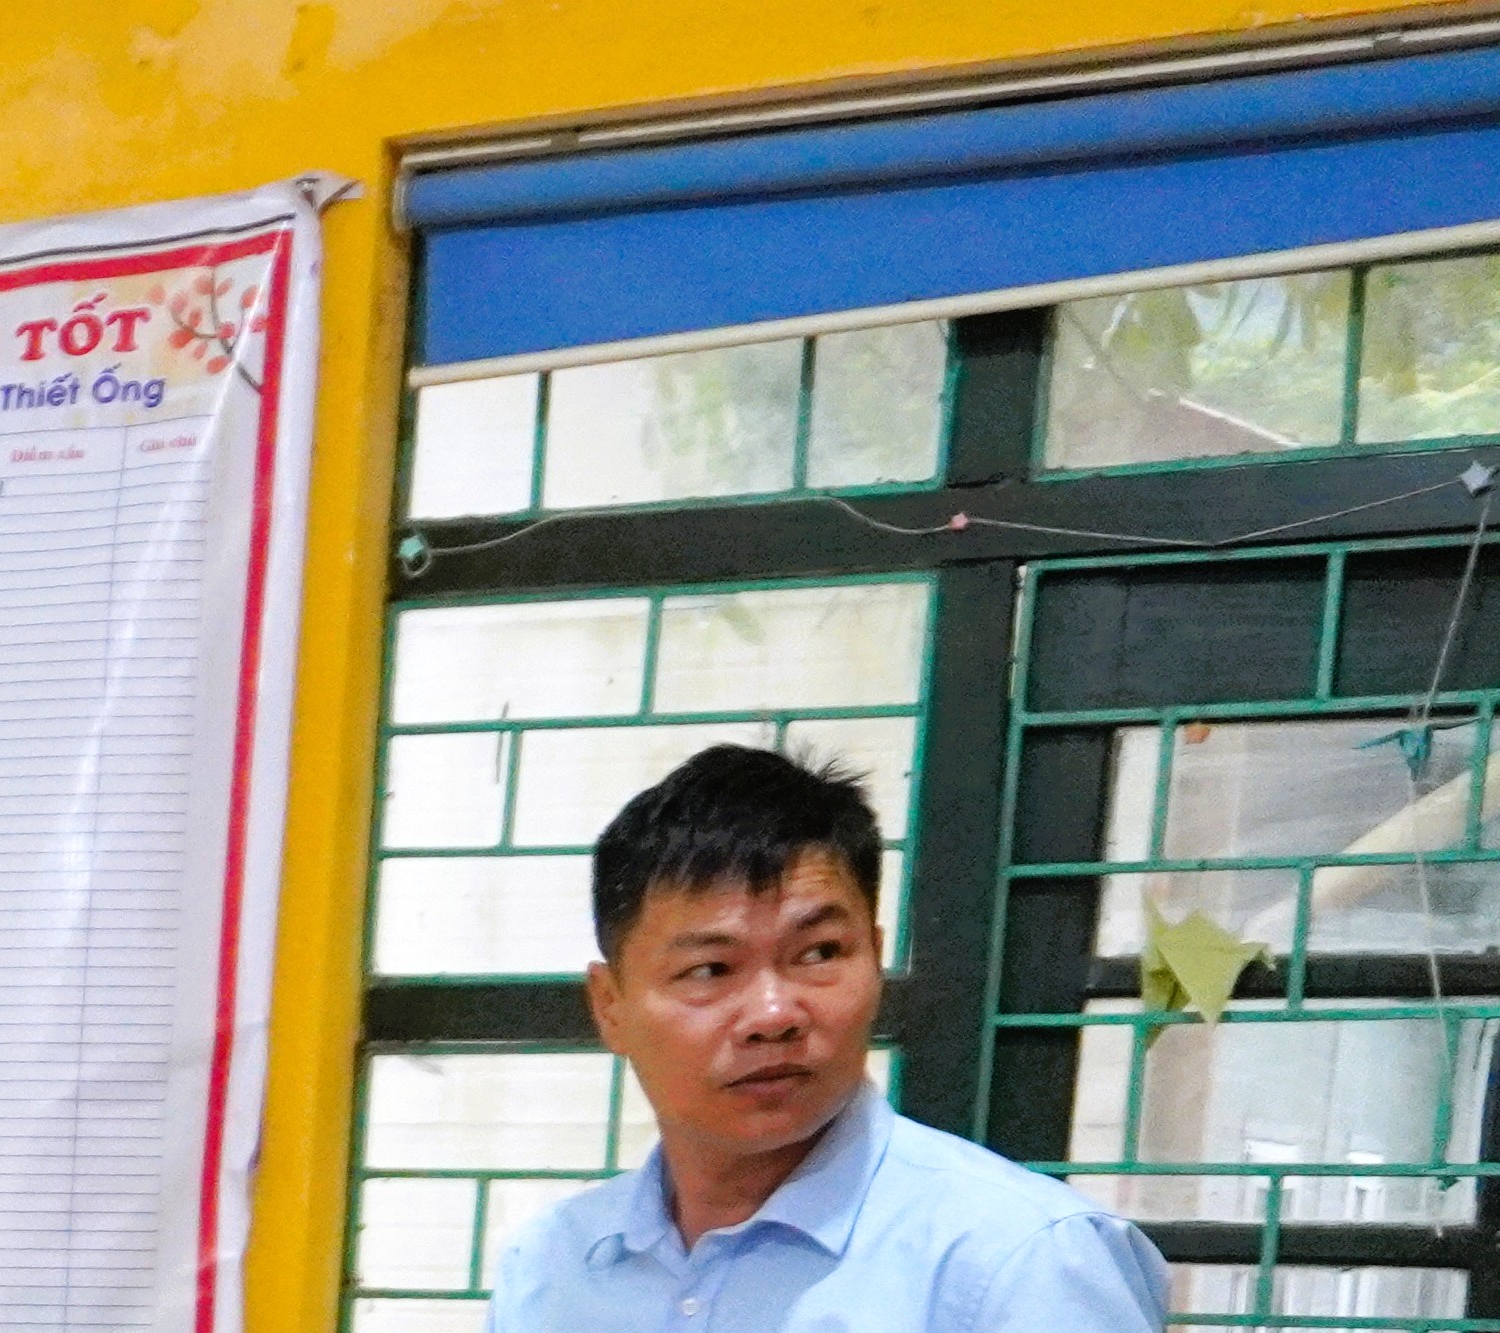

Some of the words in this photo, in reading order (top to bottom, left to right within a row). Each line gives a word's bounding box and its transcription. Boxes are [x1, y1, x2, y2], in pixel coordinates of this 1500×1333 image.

[15, 293, 151, 361] TỐT
[0, 372, 82, 411] Thiết
[91, 362, 167, 408] Ống
